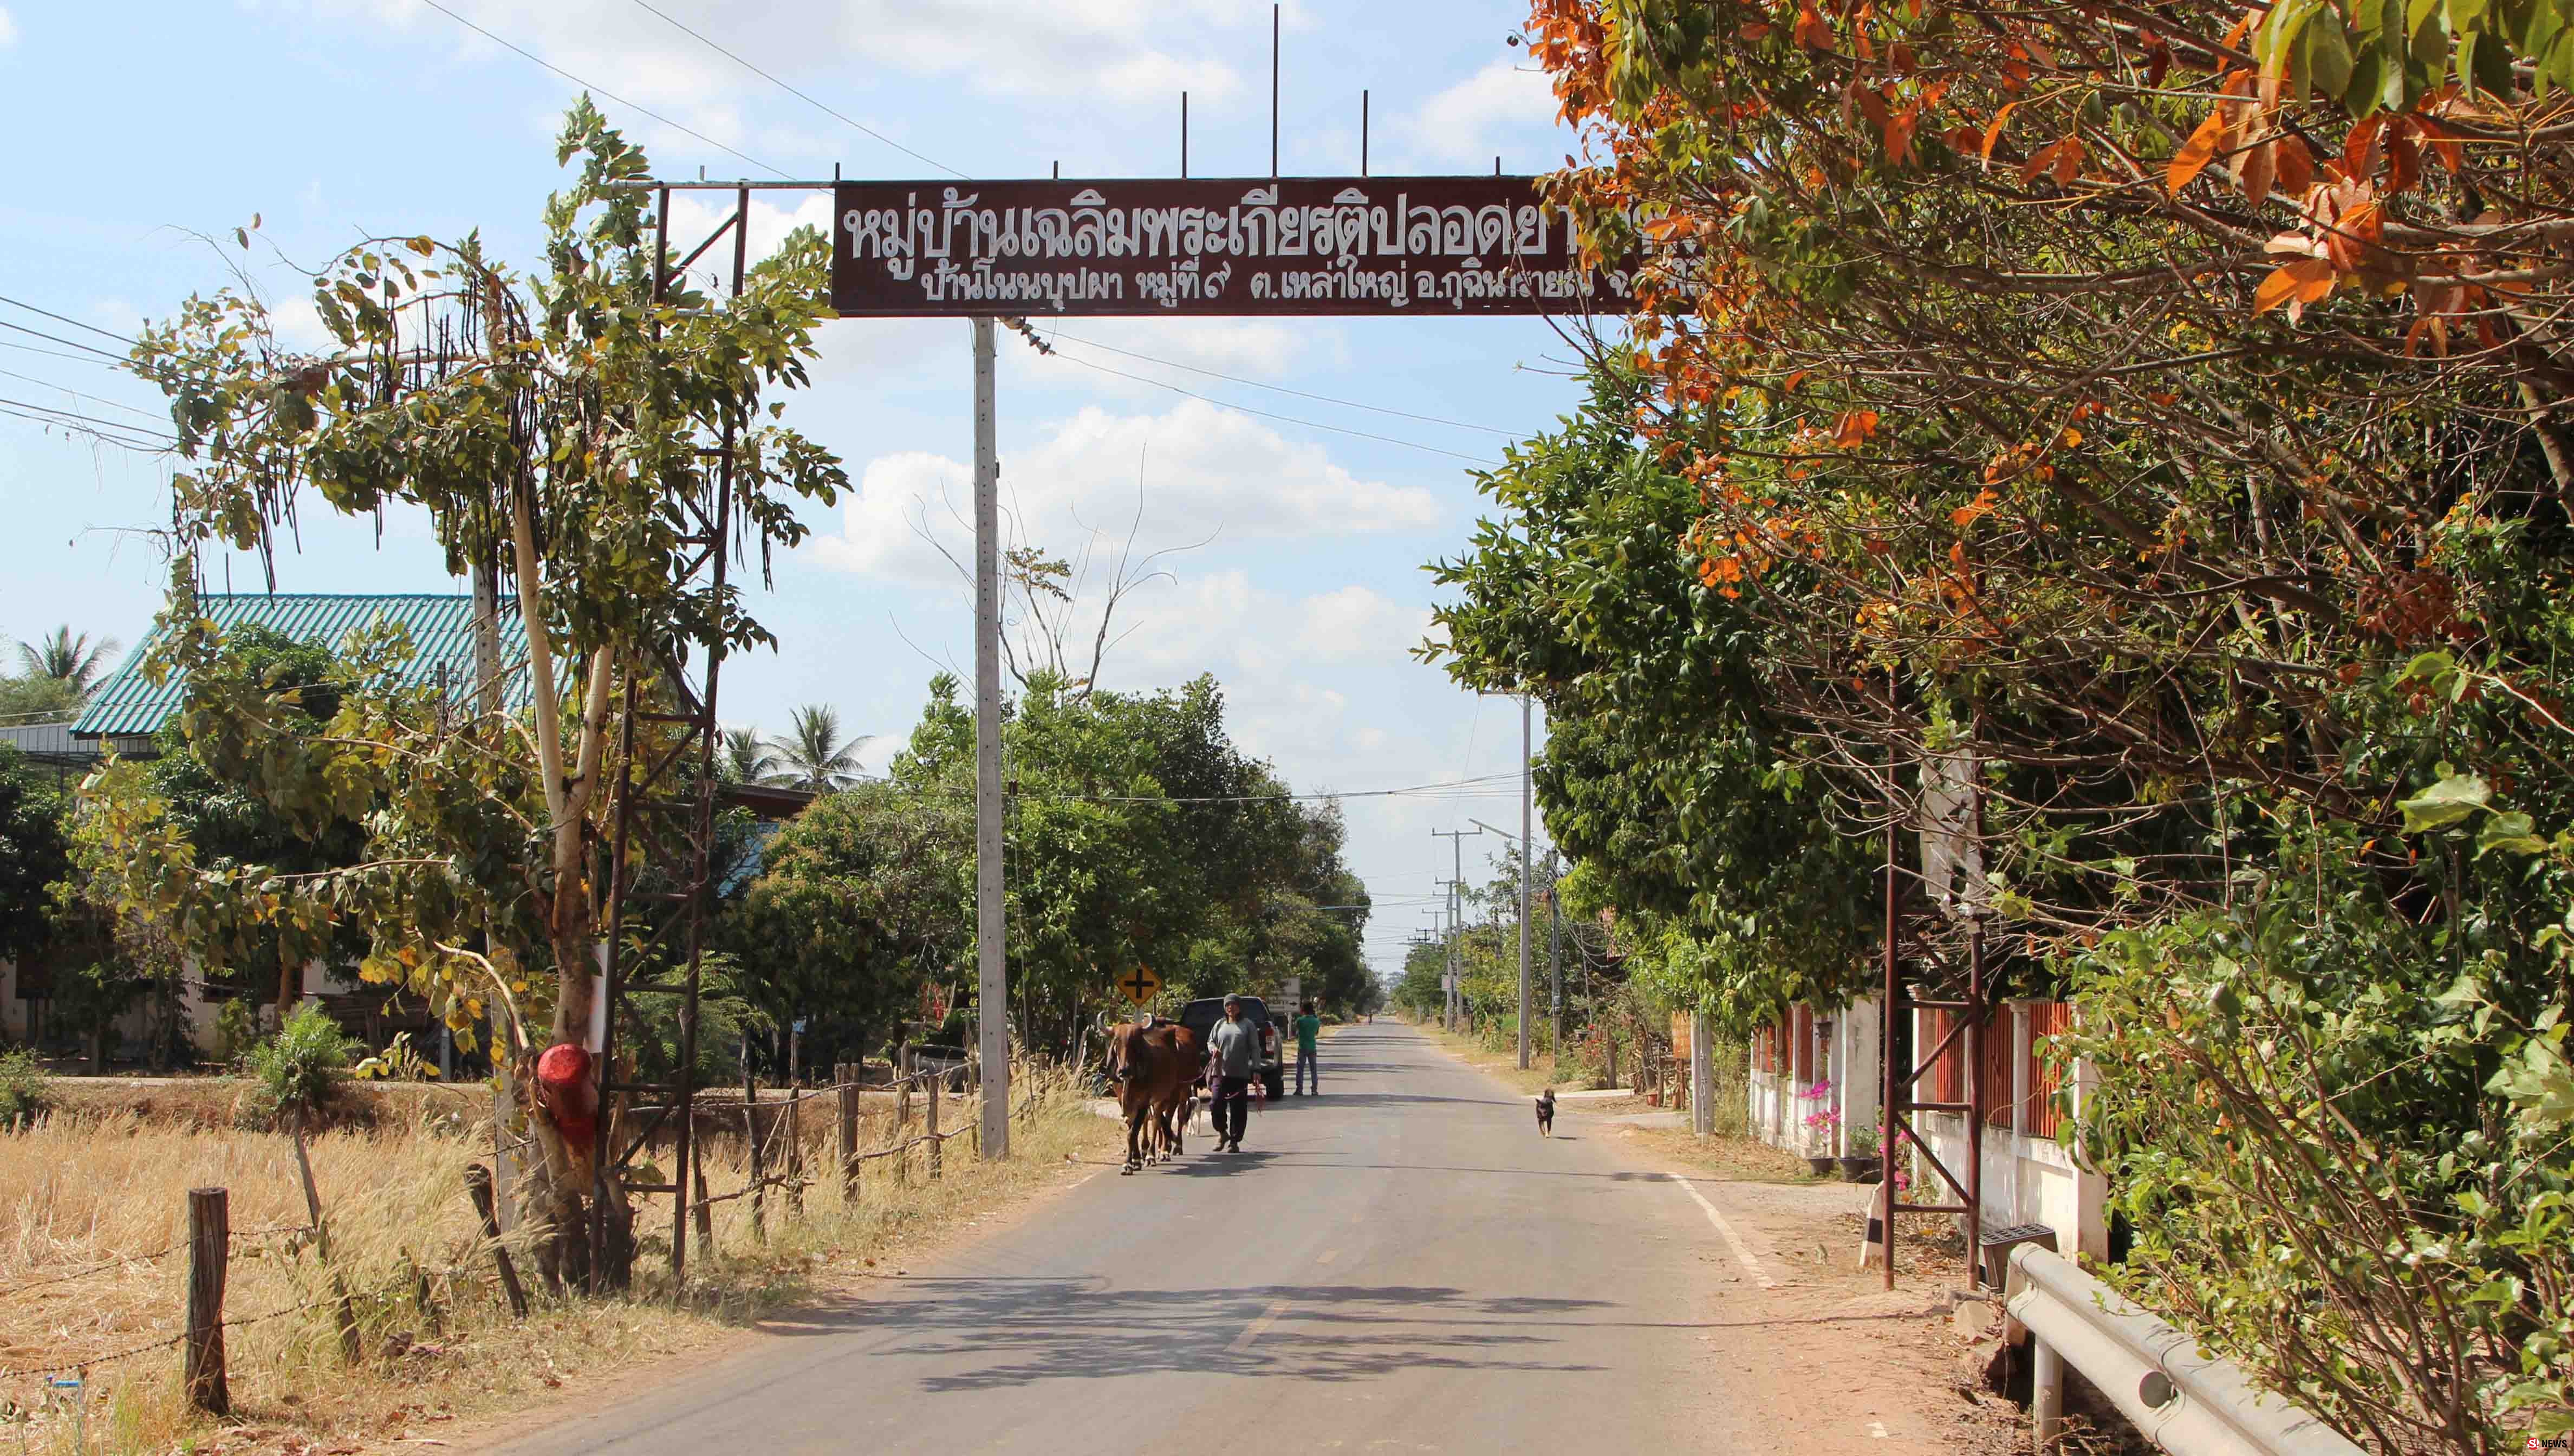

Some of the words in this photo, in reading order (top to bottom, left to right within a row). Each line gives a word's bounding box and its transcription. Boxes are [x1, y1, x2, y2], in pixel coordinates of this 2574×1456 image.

[843, 185, 1698, 280] หมู่บ้านเฉลิมพระเกียรติปลอดยา
[920, 257, 1123, 310] บ้านโนนบุปผา
